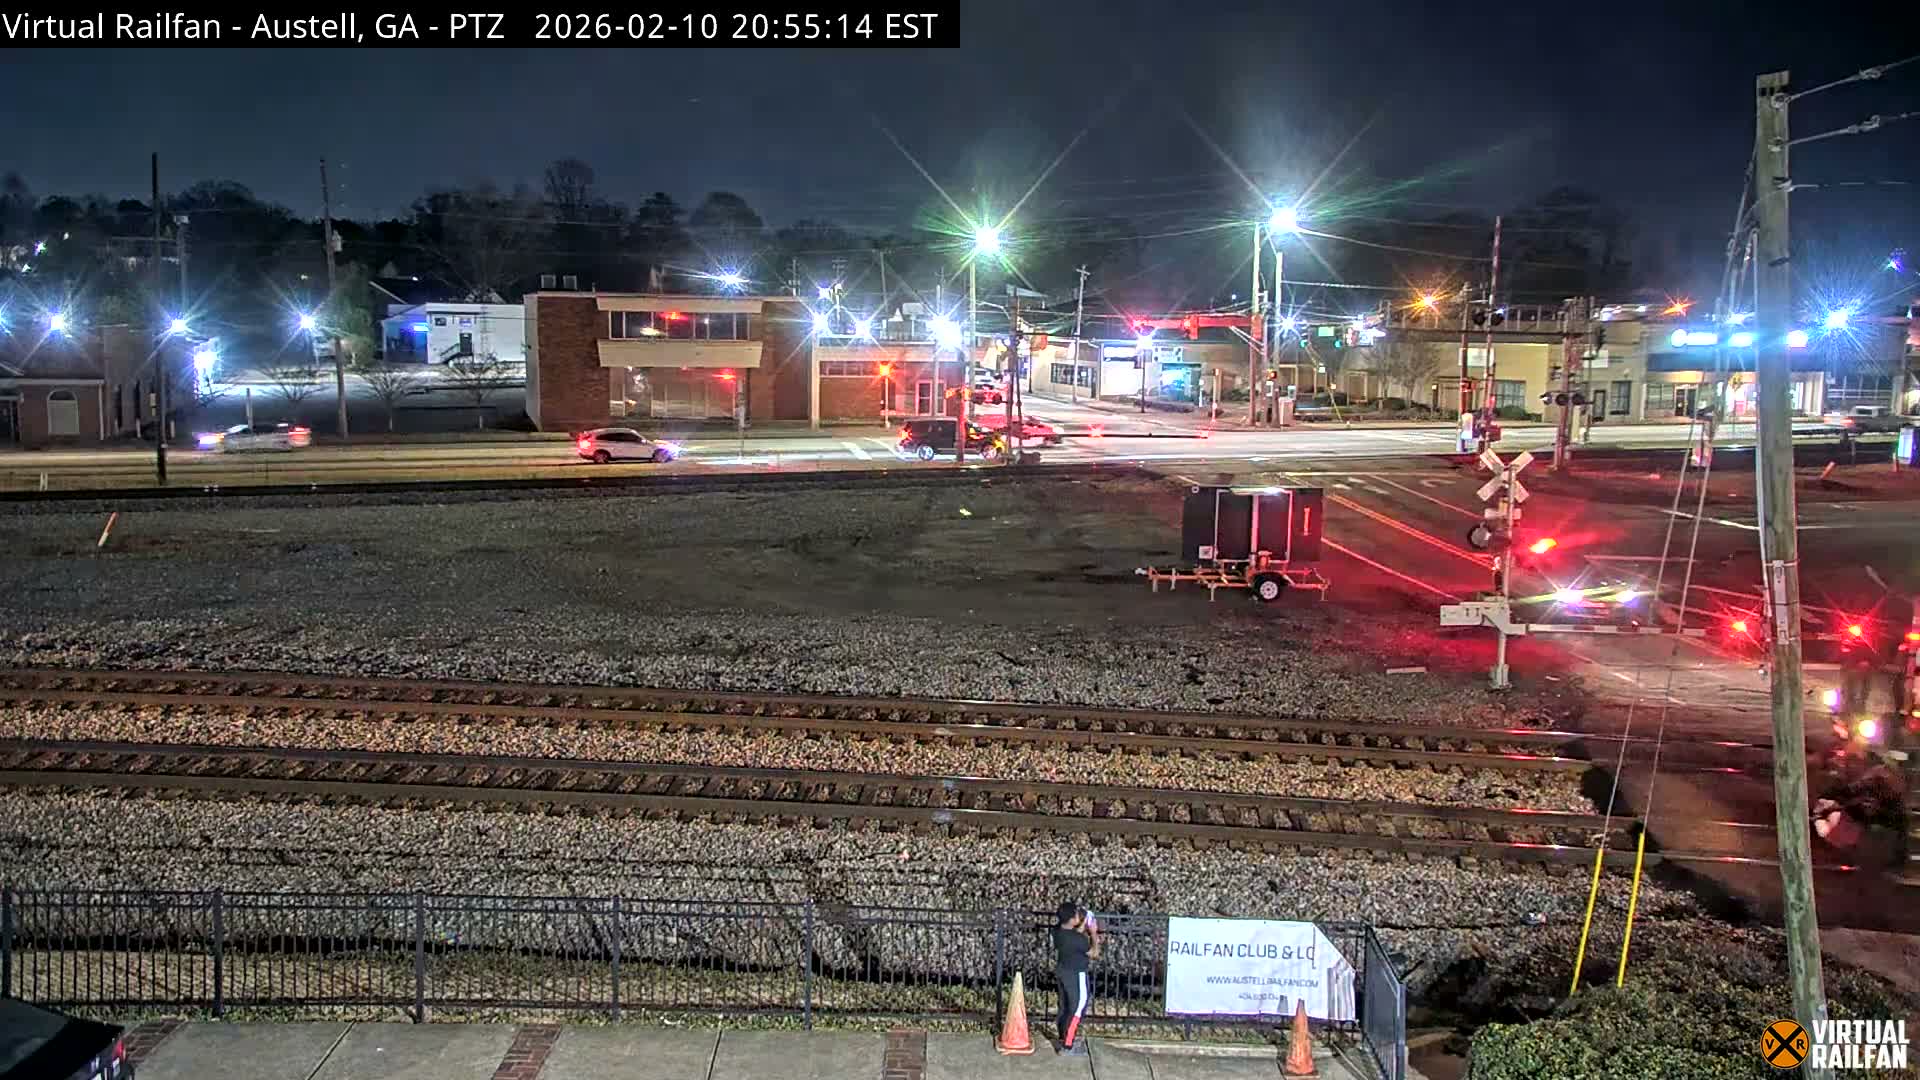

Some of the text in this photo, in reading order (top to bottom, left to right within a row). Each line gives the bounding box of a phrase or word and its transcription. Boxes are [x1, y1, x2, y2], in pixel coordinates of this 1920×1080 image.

[1170, 941, 1234, 958] RAILFAN
[1237, 943, 1277, 959] CLUB
[1281, 945, 1294, 960] &
